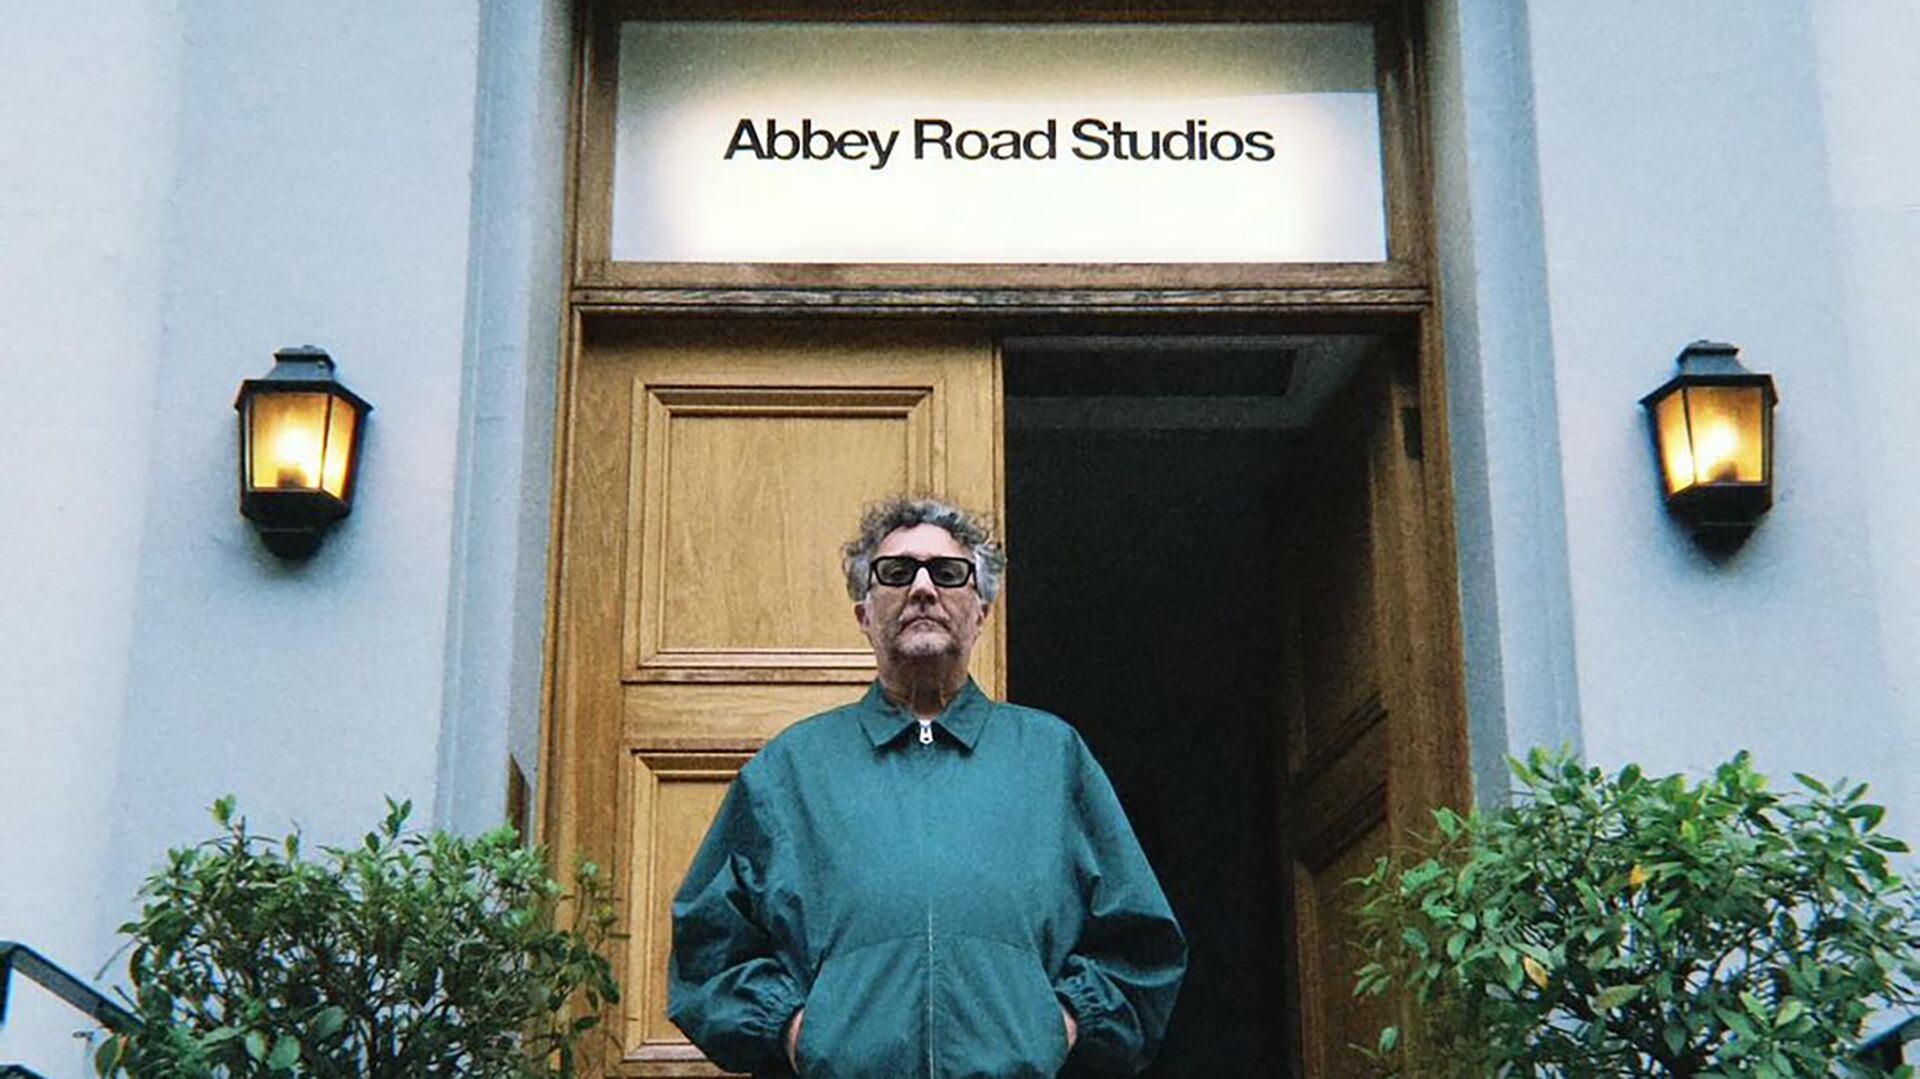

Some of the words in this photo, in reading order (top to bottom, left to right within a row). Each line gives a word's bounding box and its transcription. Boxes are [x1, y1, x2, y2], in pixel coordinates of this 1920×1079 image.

[724, 118, 899, 170] Abbey
[914, 118, 1057, 160] Road
[1072, 118, 1275, 162] Studios
